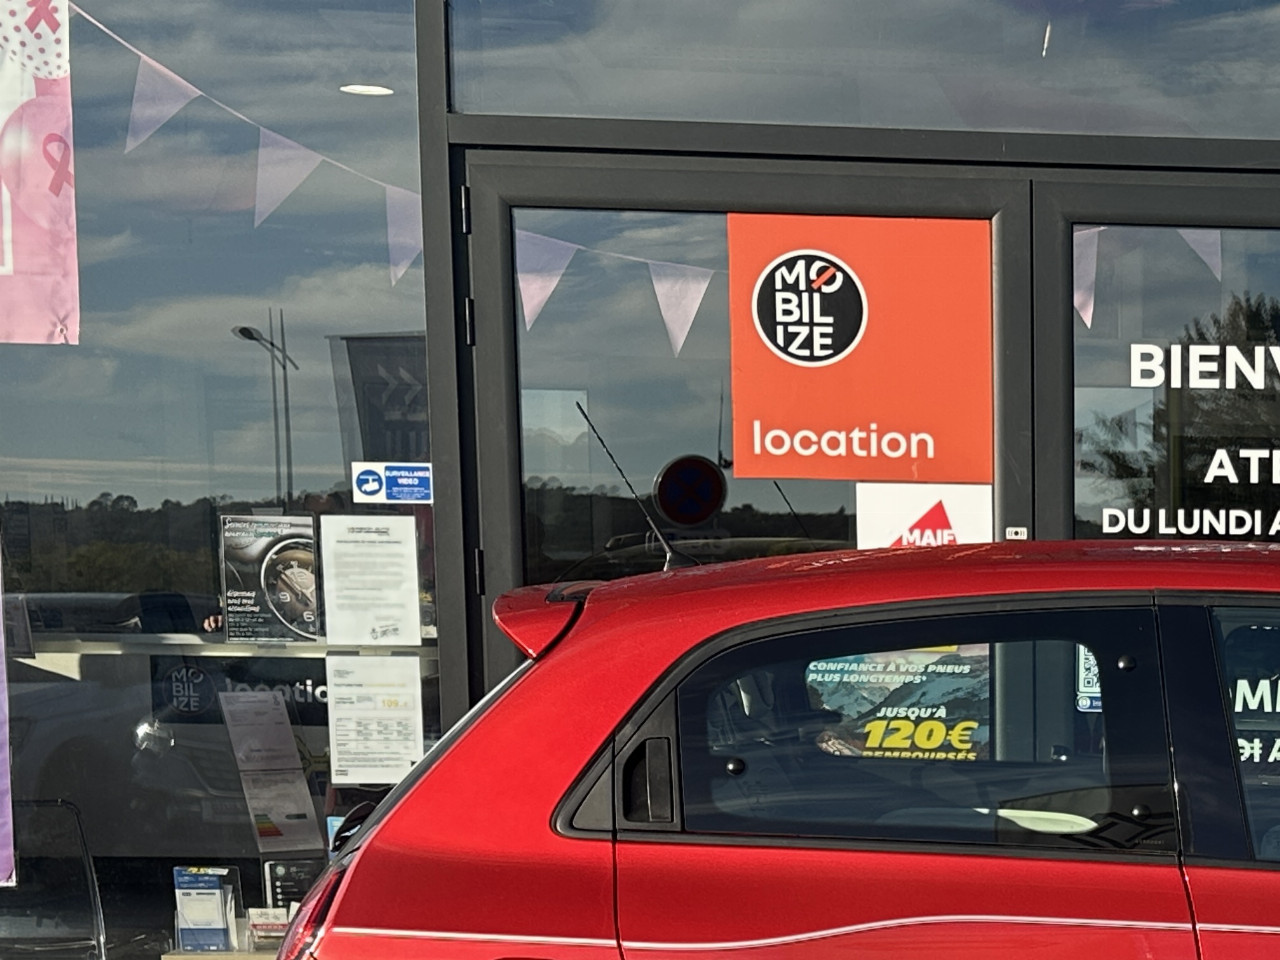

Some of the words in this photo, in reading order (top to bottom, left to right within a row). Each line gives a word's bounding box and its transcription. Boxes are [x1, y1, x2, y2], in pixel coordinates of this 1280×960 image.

[775, 291, 834, 324] BIL
[776, 325, 834, 357] IZE
[753, 420, 935, 459] location
[1101, 507, 1151, 535] DU
[1157, 508, 1262, 536] LUNDI
[901, 528, 955, 547] MAIF
[808, 673, 843, 683] PLUS
[809, 661, 885, 673] CONFIANCE
[899, 663, 925, 674] VOS
[927, 664, 971, 675] PNEUS
[876, 705, 947, 720] JUSQU'À
[863, 719, 979, 750] 120€
